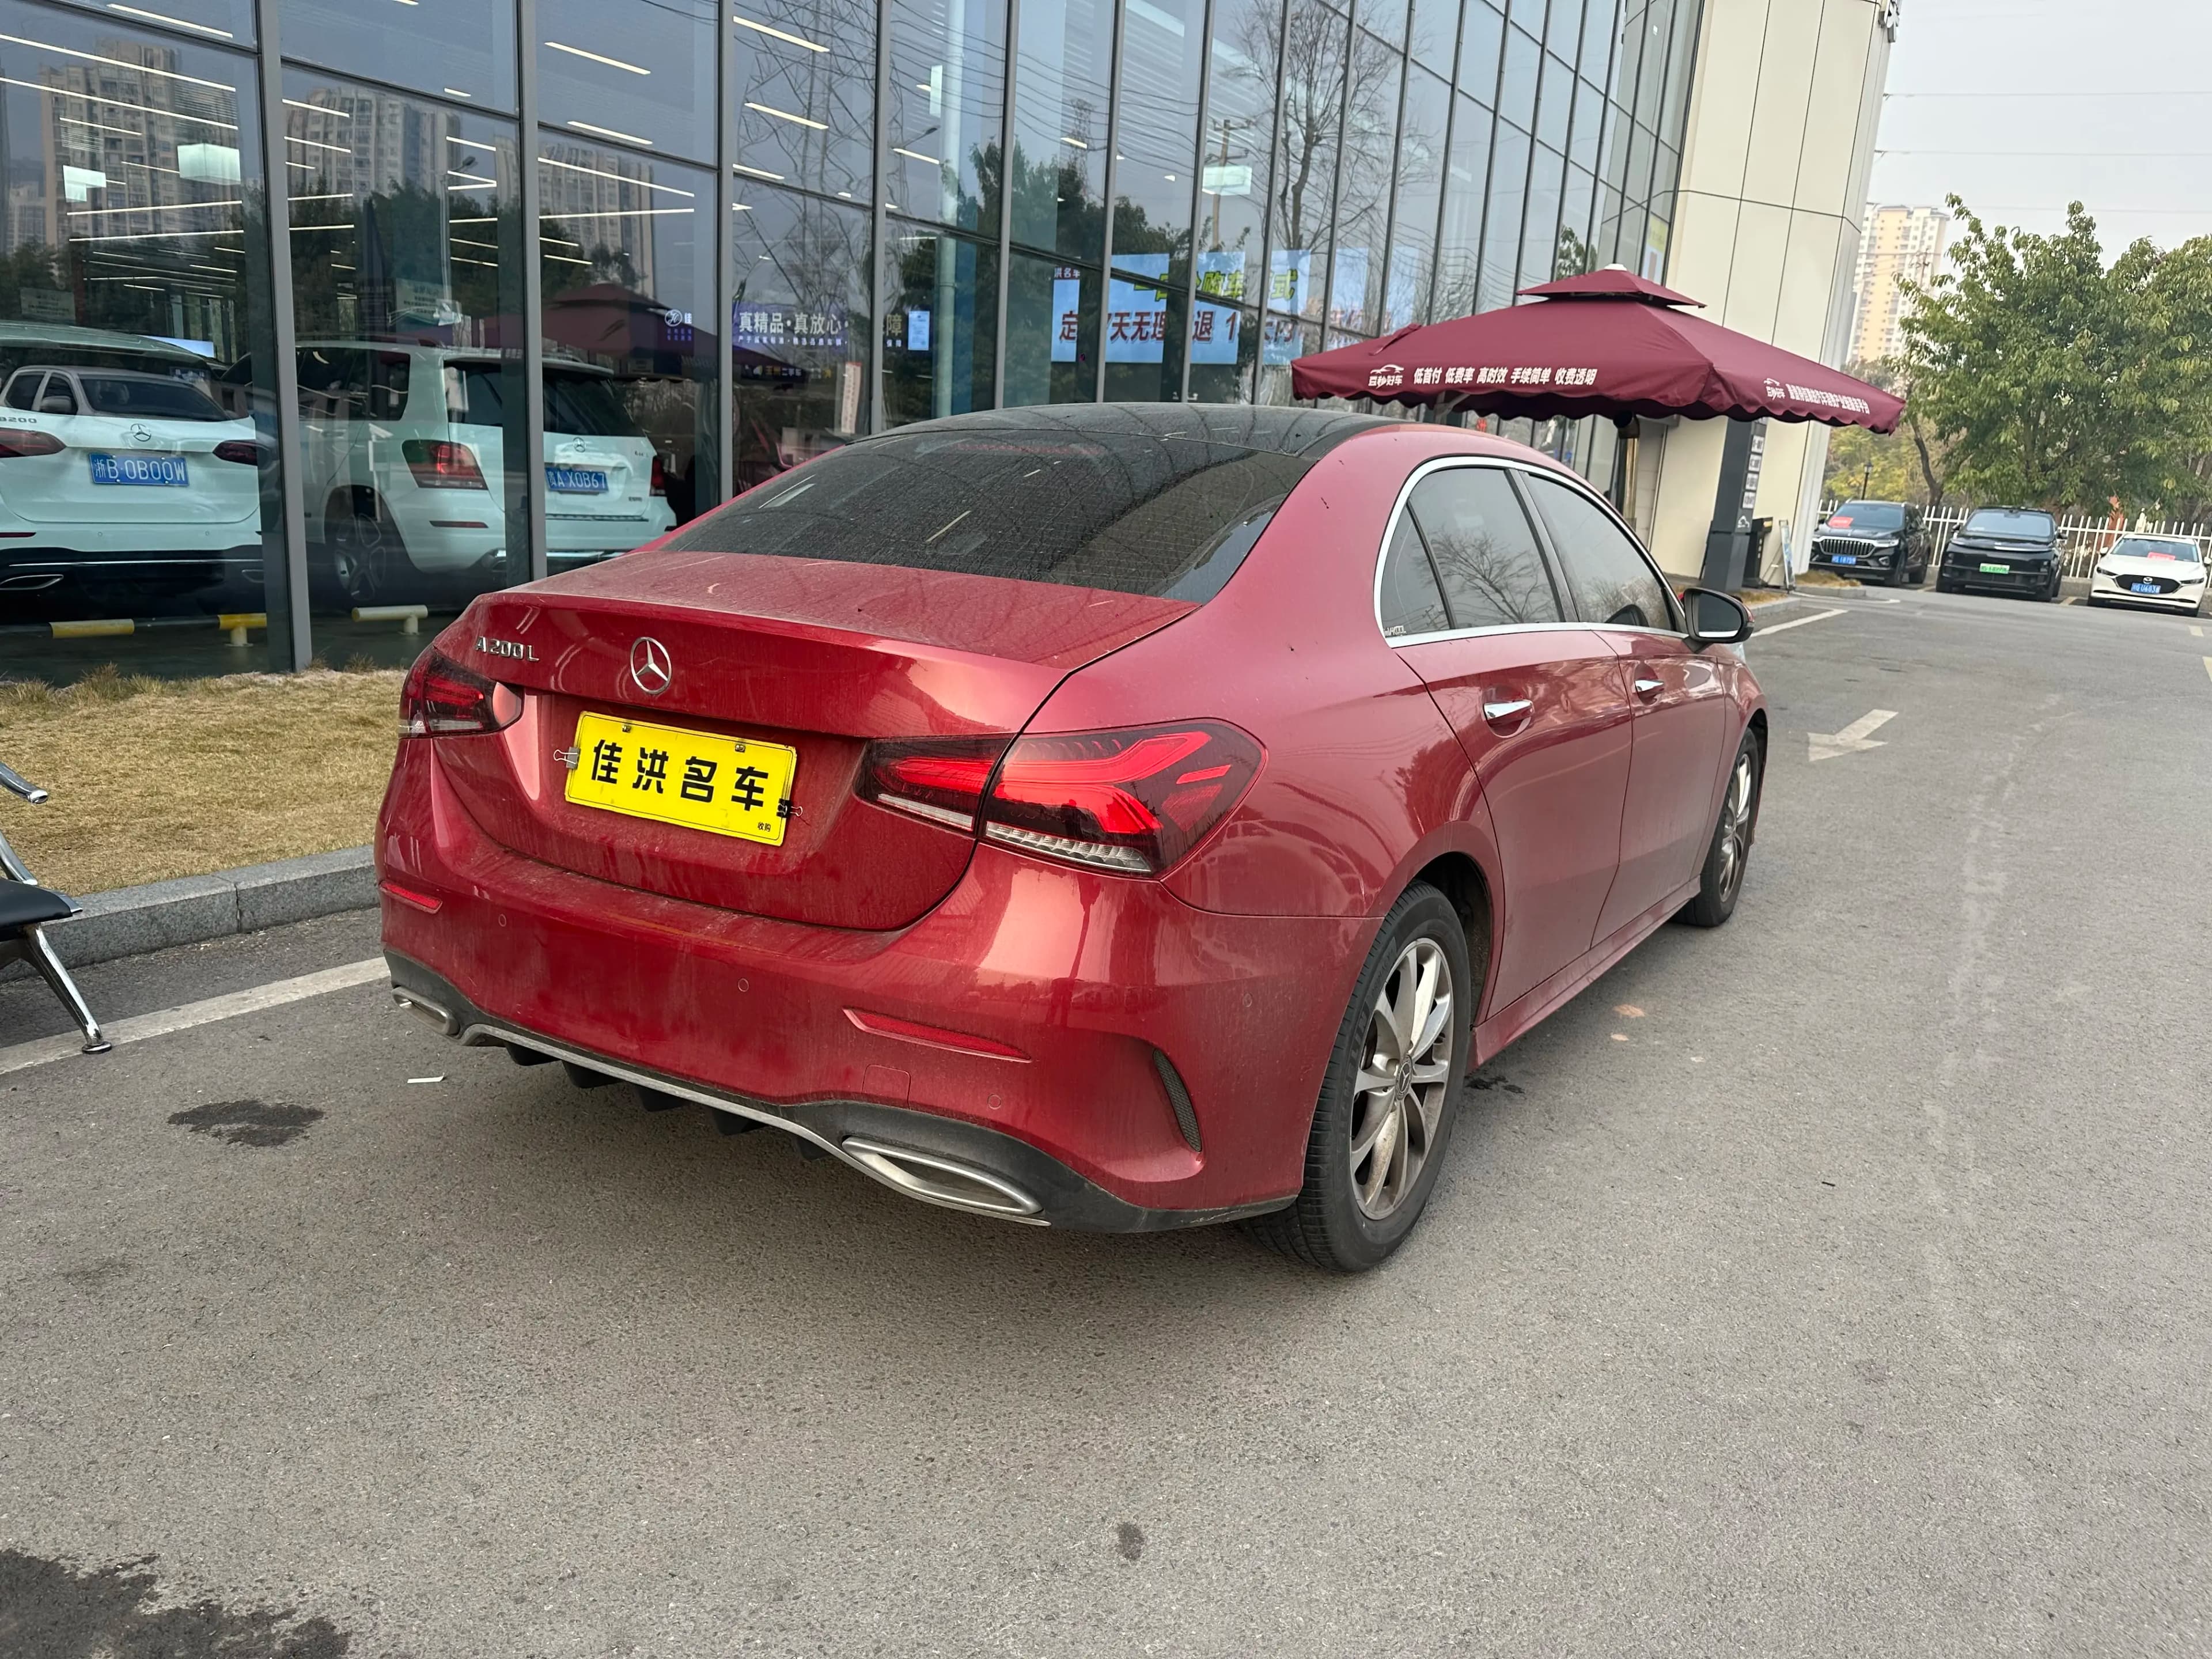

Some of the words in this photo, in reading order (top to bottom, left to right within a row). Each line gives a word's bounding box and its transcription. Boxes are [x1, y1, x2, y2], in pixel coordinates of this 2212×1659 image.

[1414, 367, 1442, 384] 低首付
[1445, 367, 1475, 384] 低费率
[1476, 367, 1508, 384] 高时效
[1510, 368, 1551, 385] 手续简单
[1554, 368, 1597, 385] 收费透明
[591, 739, 769, 811] 佳洪名车
